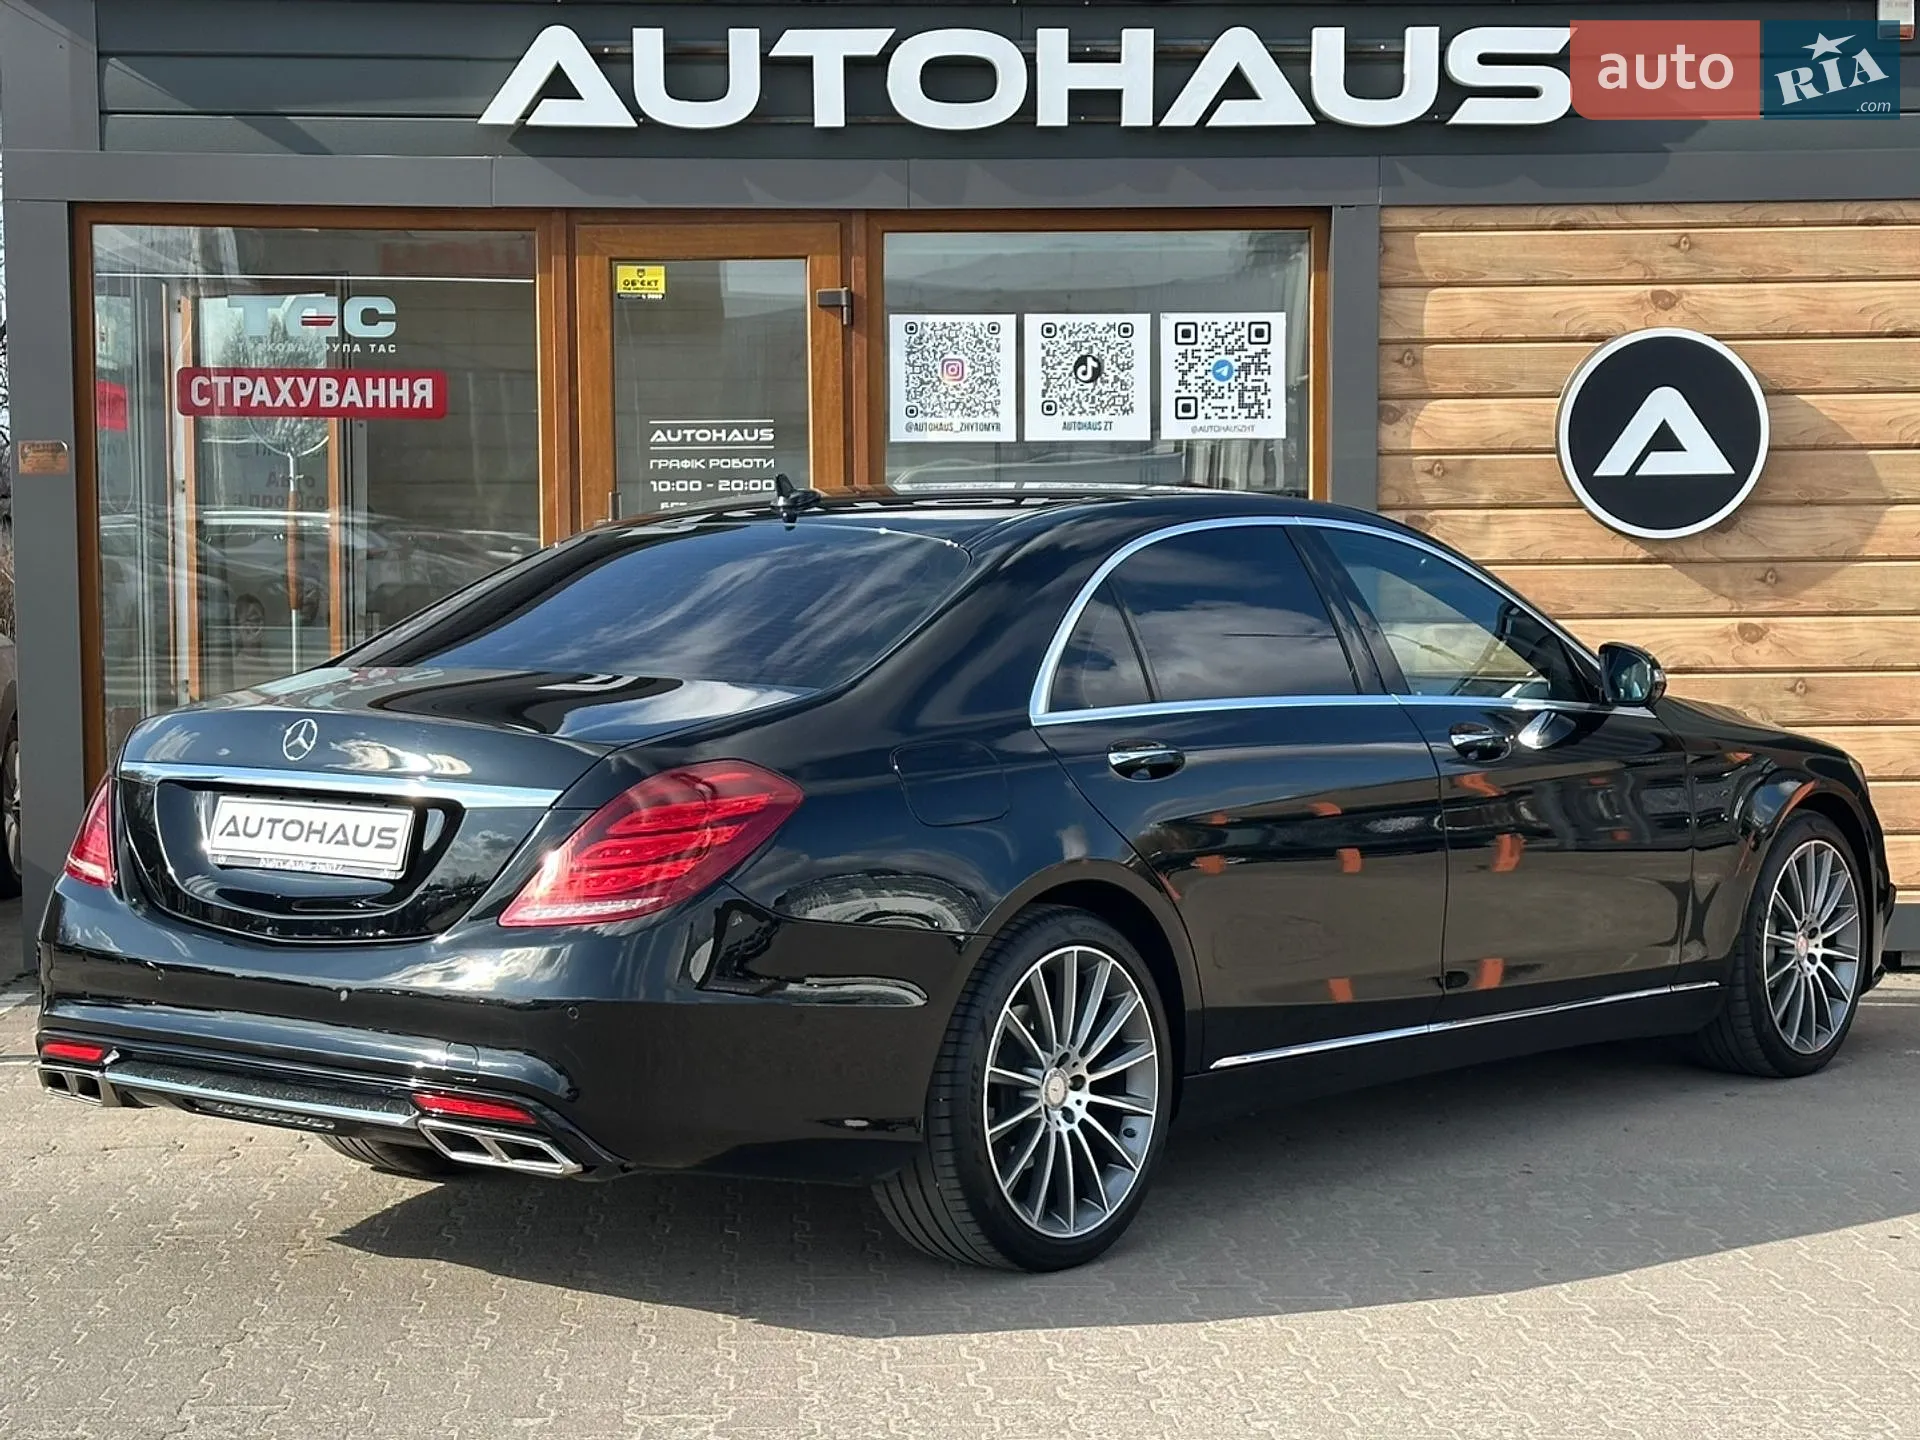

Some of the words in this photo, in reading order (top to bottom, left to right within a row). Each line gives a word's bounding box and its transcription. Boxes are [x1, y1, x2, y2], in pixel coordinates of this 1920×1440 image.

[477, 25, 1578, 129] AUTOHAUS
[368, 343, 396, 353] ТАС
[190, 376, 434, 408] СТРАХУВАННЯ
[650, 429, 774, 442] AUTOHAUS
[649, 459, 706, 469] ГРАФІК
[709, 459, 775, 469] РОБОТИ
[650, 480, 702, 492] 10:00
[718, 480, 775, 491] 20:00
[218, 814, 400, 850] AUTOHAUS
